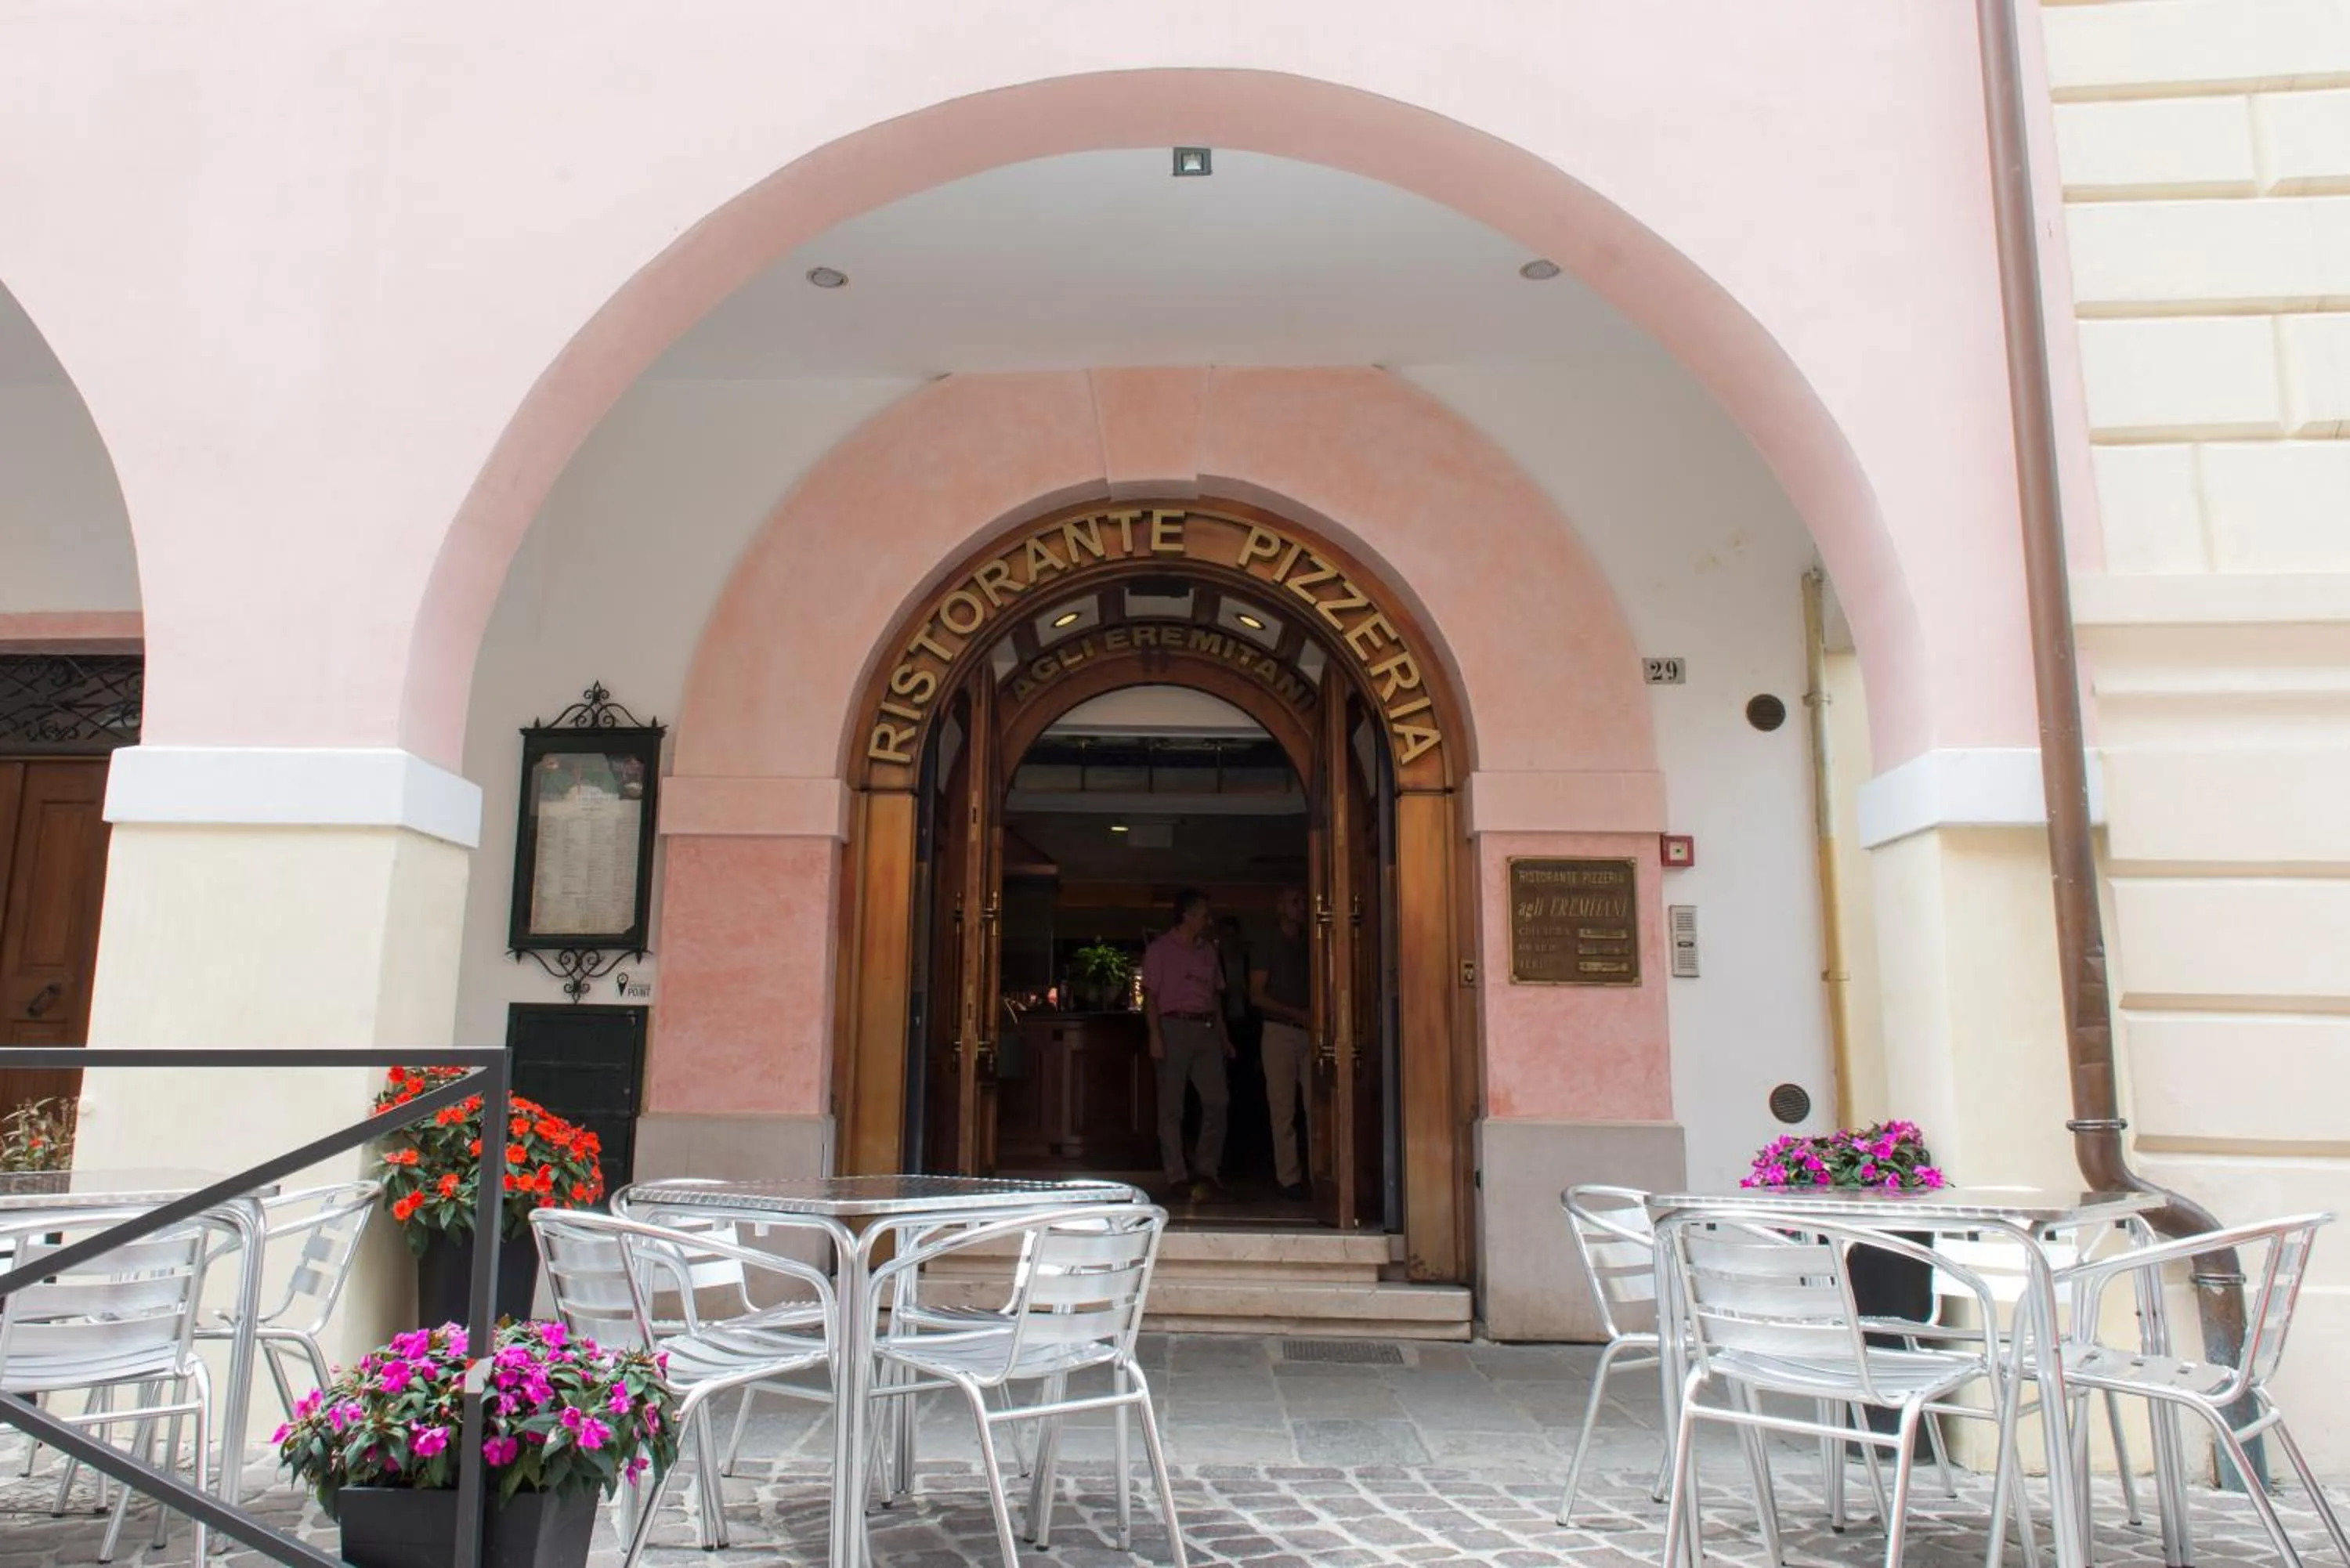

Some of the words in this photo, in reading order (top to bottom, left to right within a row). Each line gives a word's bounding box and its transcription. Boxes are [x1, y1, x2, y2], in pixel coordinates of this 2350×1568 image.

[868, 508, 1185, 765] RISTORANTE
[1238, 526, 1442, 765] PIZZERIA
[1012, 638, 1095, 703] AGLI
[1104, 627, 1317, 711] EREMITANI
[1650, 661, 1678, 681] 29
